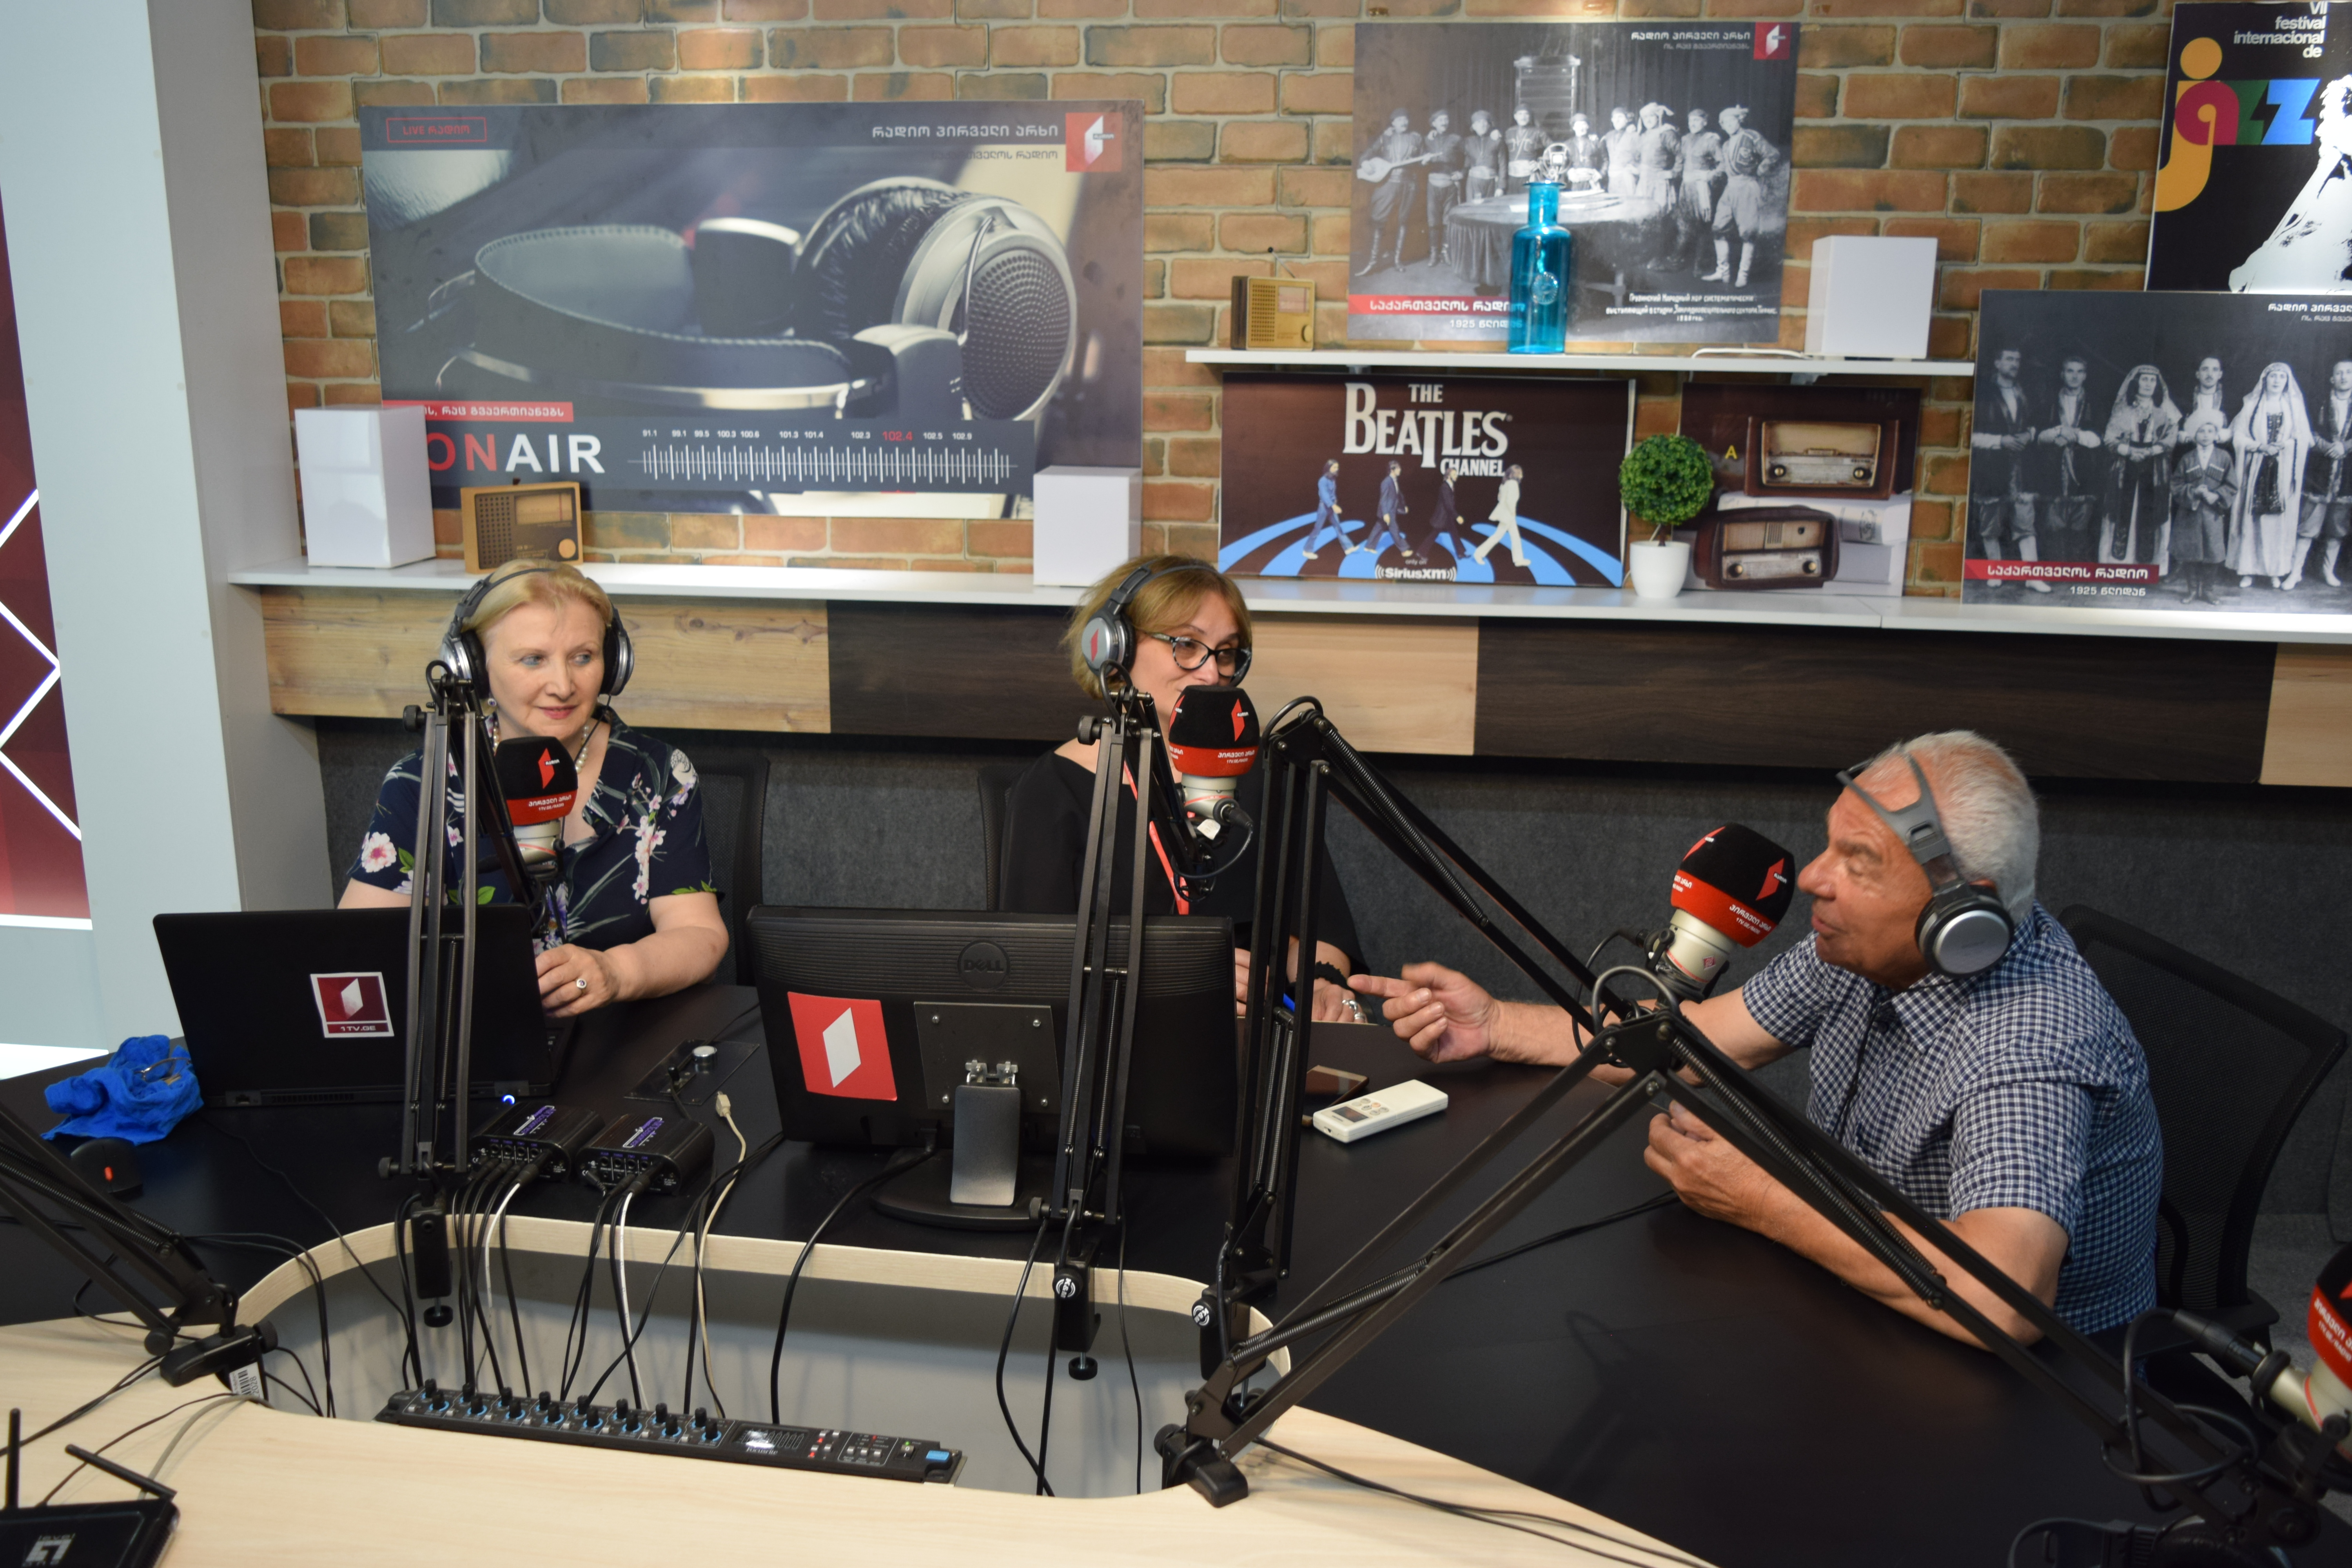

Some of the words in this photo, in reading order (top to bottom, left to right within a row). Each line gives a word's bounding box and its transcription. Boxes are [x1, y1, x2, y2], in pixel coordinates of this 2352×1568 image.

[2275, 15, 2327, 30] festival
[2234, 30, 2325, 44] internacional
[2303, 44, 2322, 58] de
[403, 126, 425, 135] LIVE
[873, 126, 930, 138] რადიო
[936, 126, 1009, 137] პირველი
[1016, 125, 1057, 136] არხი
[1016, 151, 1058, 160] რადიო
[1370, 300, 1468, 311] საქართველოს
[2310, 304, 2352, 313] პირველ
[1450, 319, 1475, 328] 1925
[1408, 384, 1443, 403] THE
[442, 406, 466, 416] რაც
[1343, 383, 1508, 468] BEATLES
[882, 431, 913, 441] 102.4
[427, 432, 497, 471] ON
[505, 434, 605, 473] AIR
[1725, 445, 1737, 459] A
[1440, 458, 1505, 477] CHANNEL
[1987, 565, 2091, 578] საქართველოს
[2095, 568, 2148, 579] რადიო
[2070, 586, 2096, 595] 1925
[2101, 587, 2146, 596] წლიდან
[964, 958, 1004, 972] DELL
